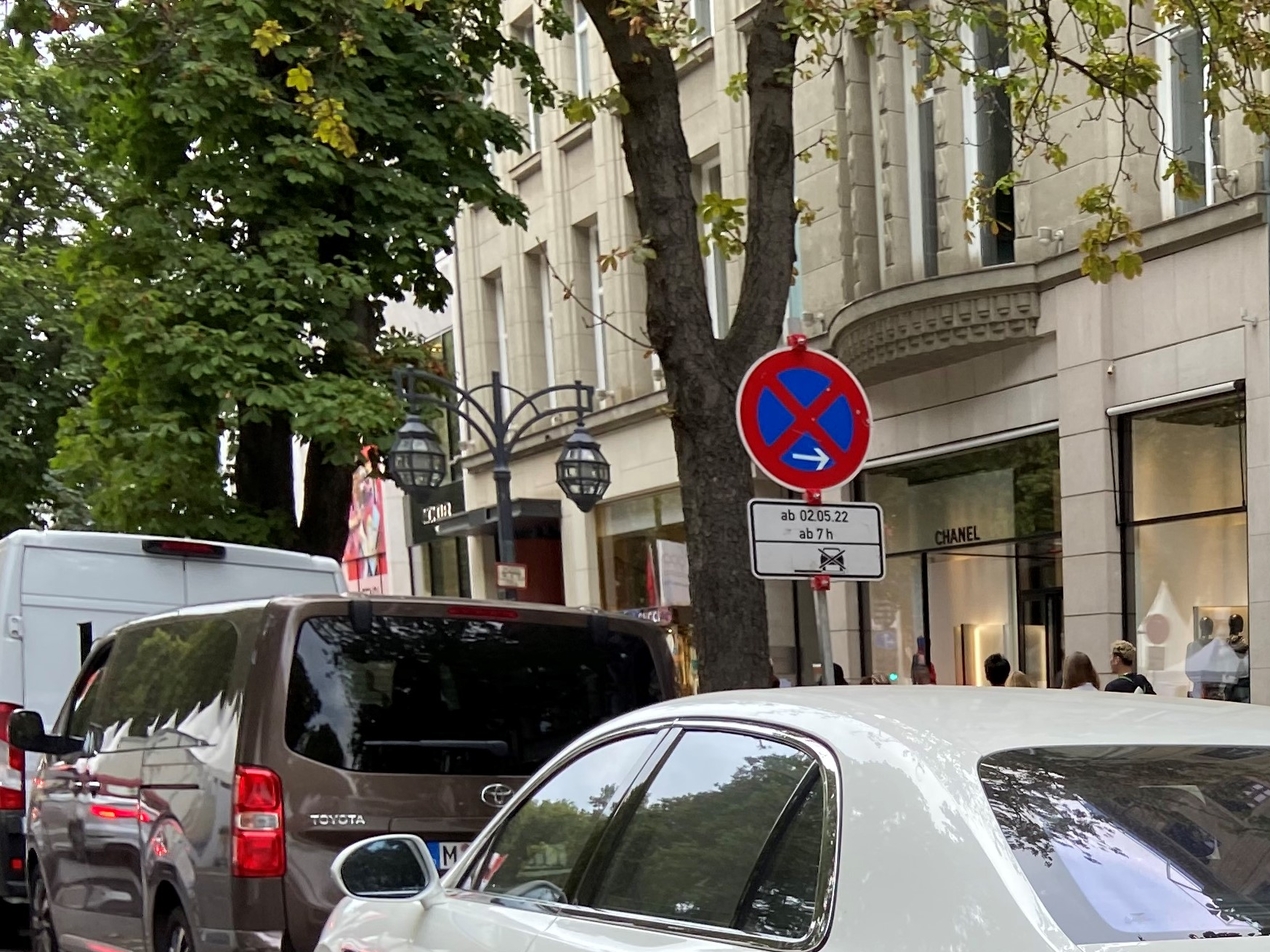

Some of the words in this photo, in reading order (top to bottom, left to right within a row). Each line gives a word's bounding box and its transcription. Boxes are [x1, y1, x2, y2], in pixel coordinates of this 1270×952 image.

[781, 509, 796, 521] ab
[800, 509, 848, 523] 02.05.22
[799, 528, 814, 540] ab
[816, 528, 824, 540] 7
[826, 528, 834, 540] h
[935, 525, 981, 545] CHANEL
[309, 814, 366, 826] TOYOTA
[442, 845, 458, 867] M
